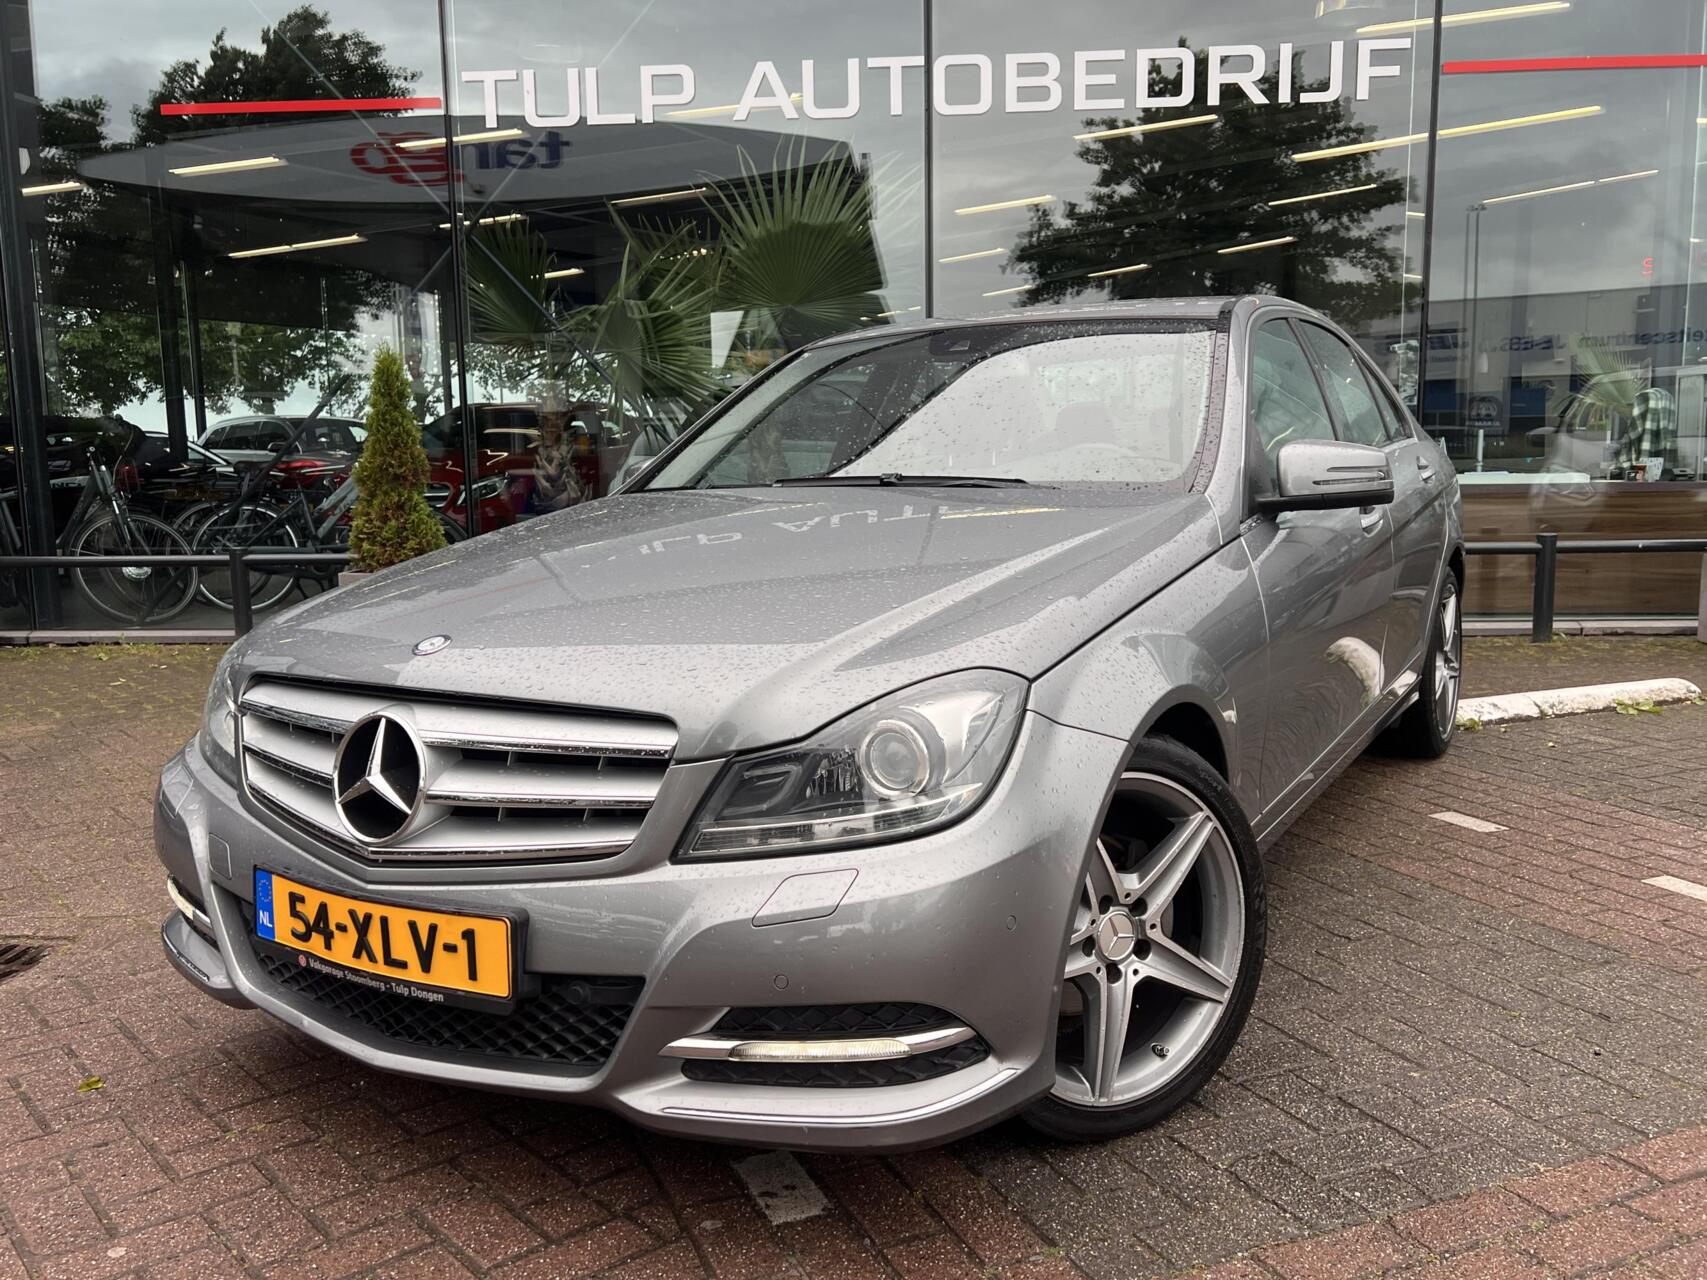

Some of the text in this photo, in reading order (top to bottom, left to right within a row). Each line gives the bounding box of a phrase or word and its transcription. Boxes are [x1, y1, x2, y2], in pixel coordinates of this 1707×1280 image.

[461, 37, 1413, 128] TULP AUTOBEDRIJF
[259, 909, 273, 928] NL
[288, 891, 478, 982] 54-XLV-1
[390, 982, 410, 997] Tulp
[410, 986, 444, 1003] Dongen
